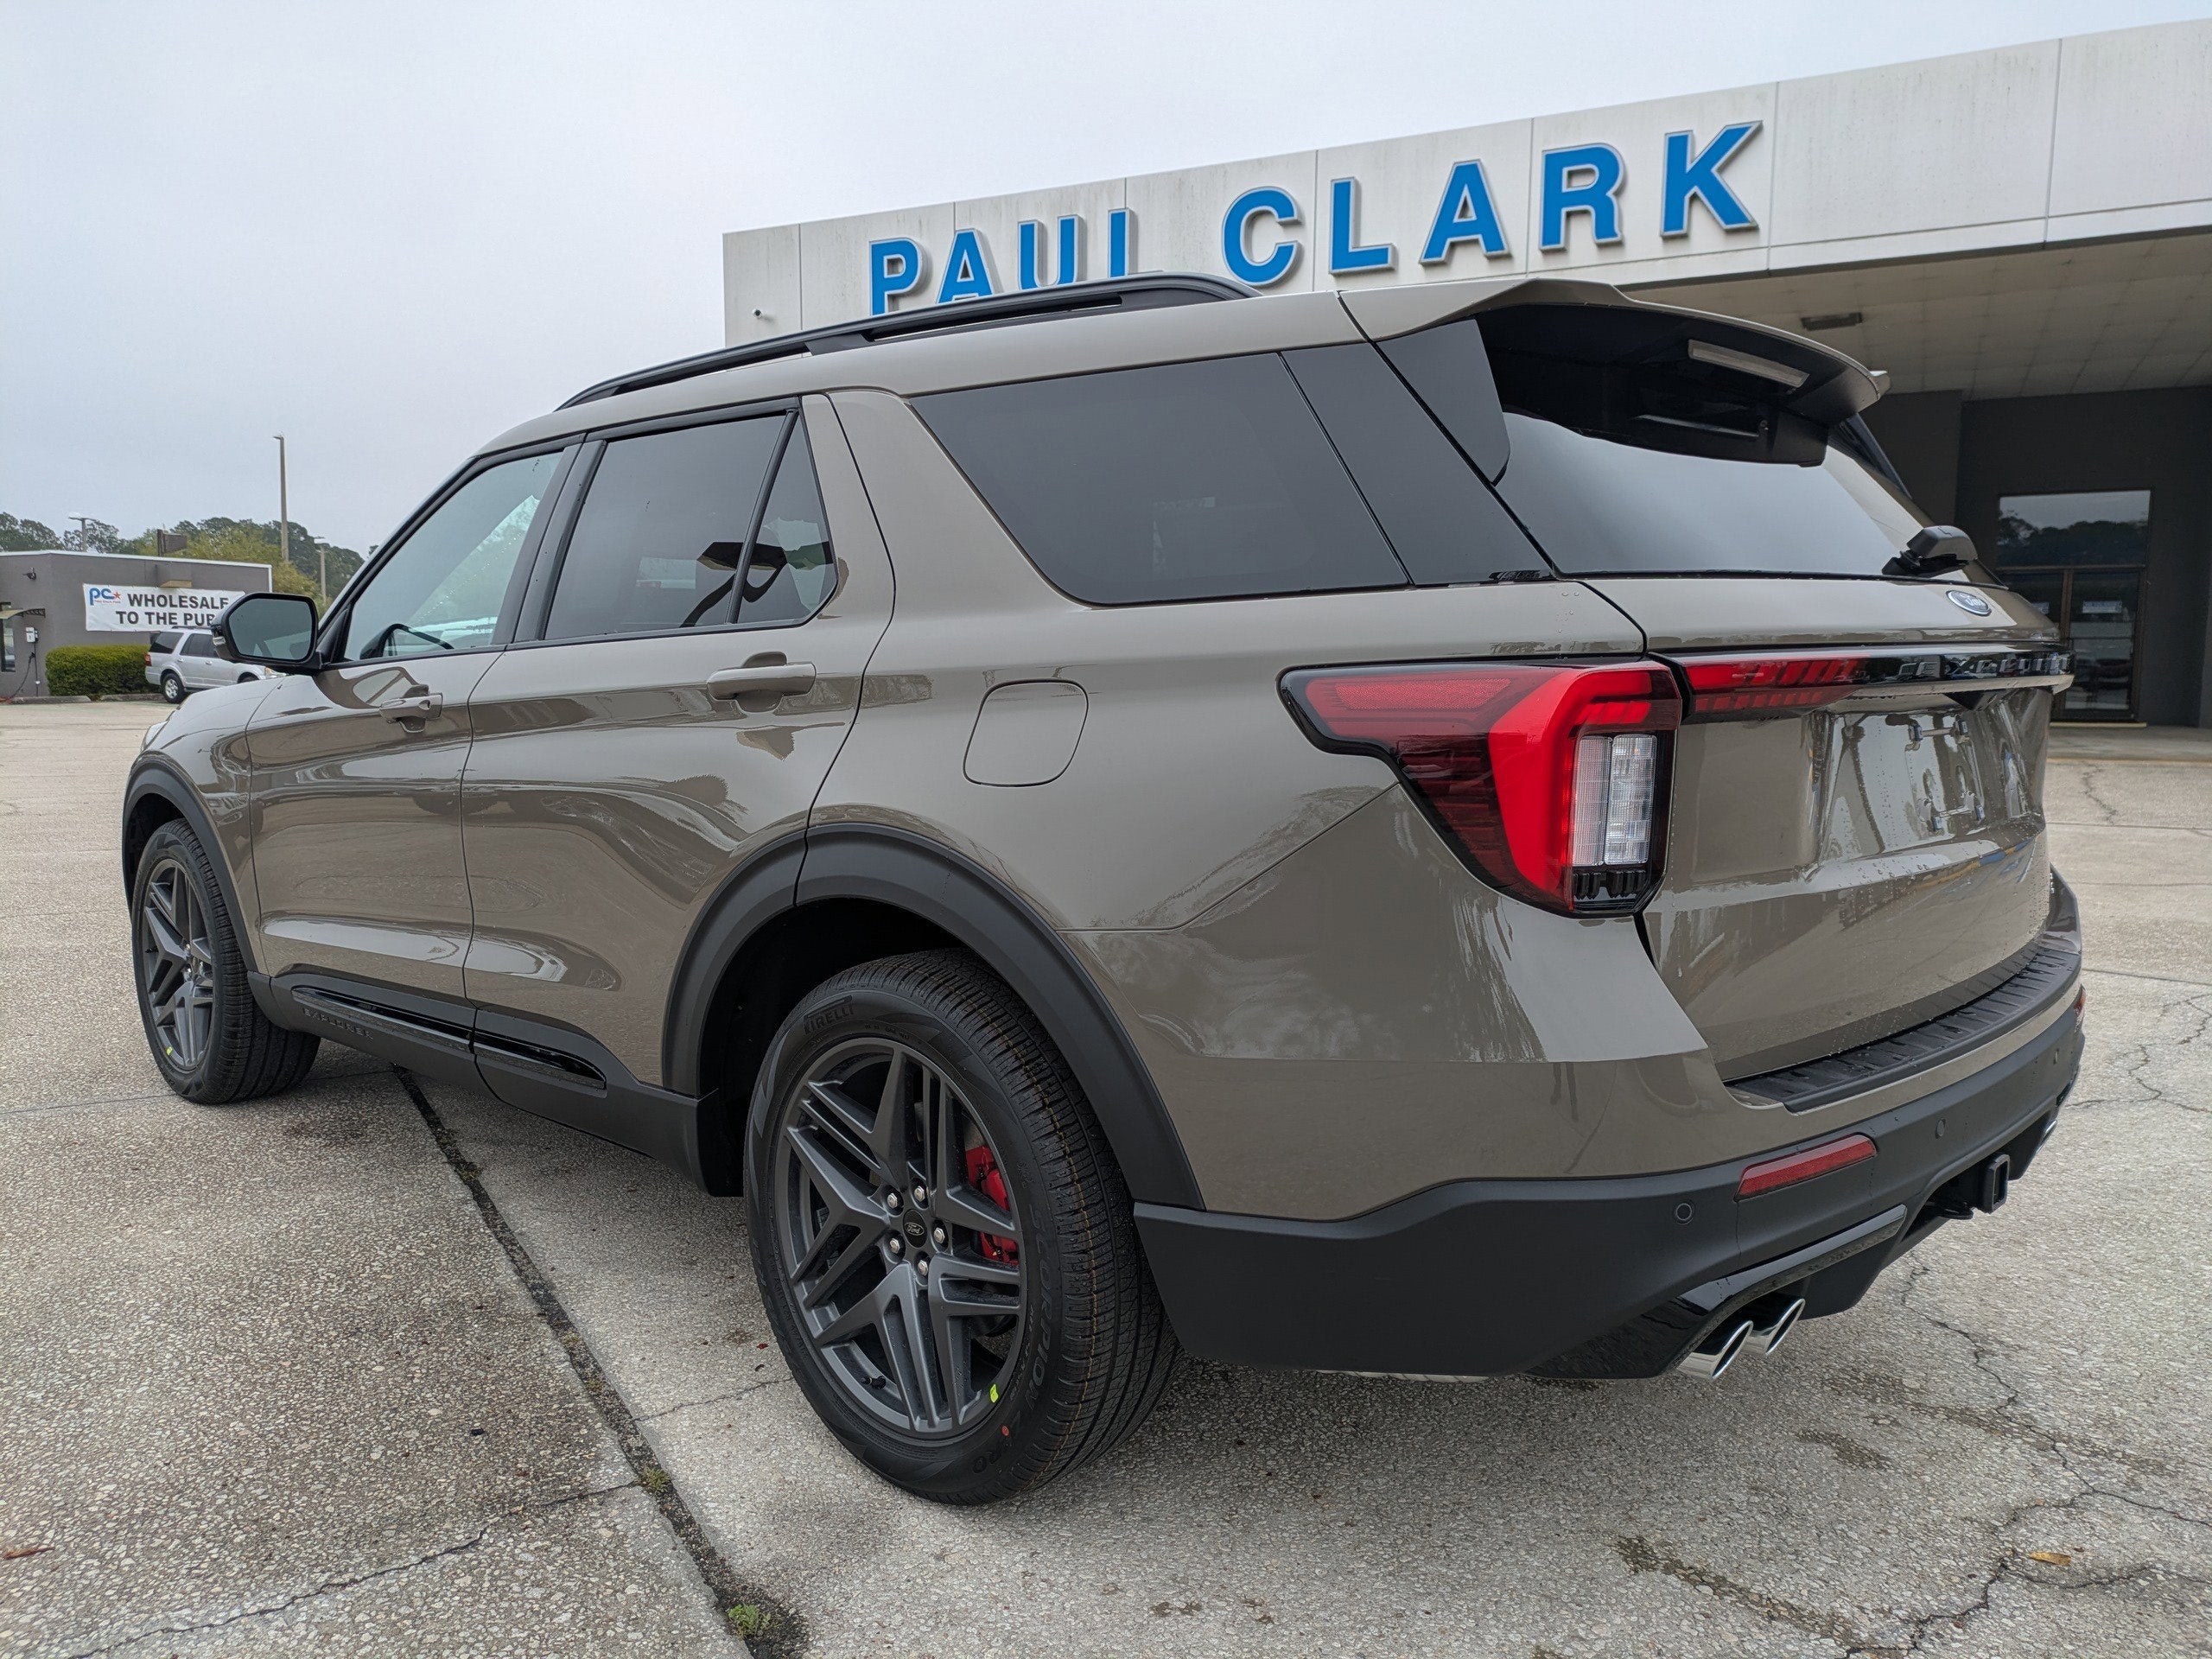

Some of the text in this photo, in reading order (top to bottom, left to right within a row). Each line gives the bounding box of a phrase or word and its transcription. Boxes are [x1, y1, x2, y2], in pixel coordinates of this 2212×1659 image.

[869, 119, 1764, 316] PAUL CLARK
[116, 611, 139, 625] TO
[144, 612, 178, 626] THE
[128, 594, 229, 610] WHOLESALE
[804, 995, 854, 1035] PIRELLI
[1025, 1203, 1053, 1410] SCORPION
